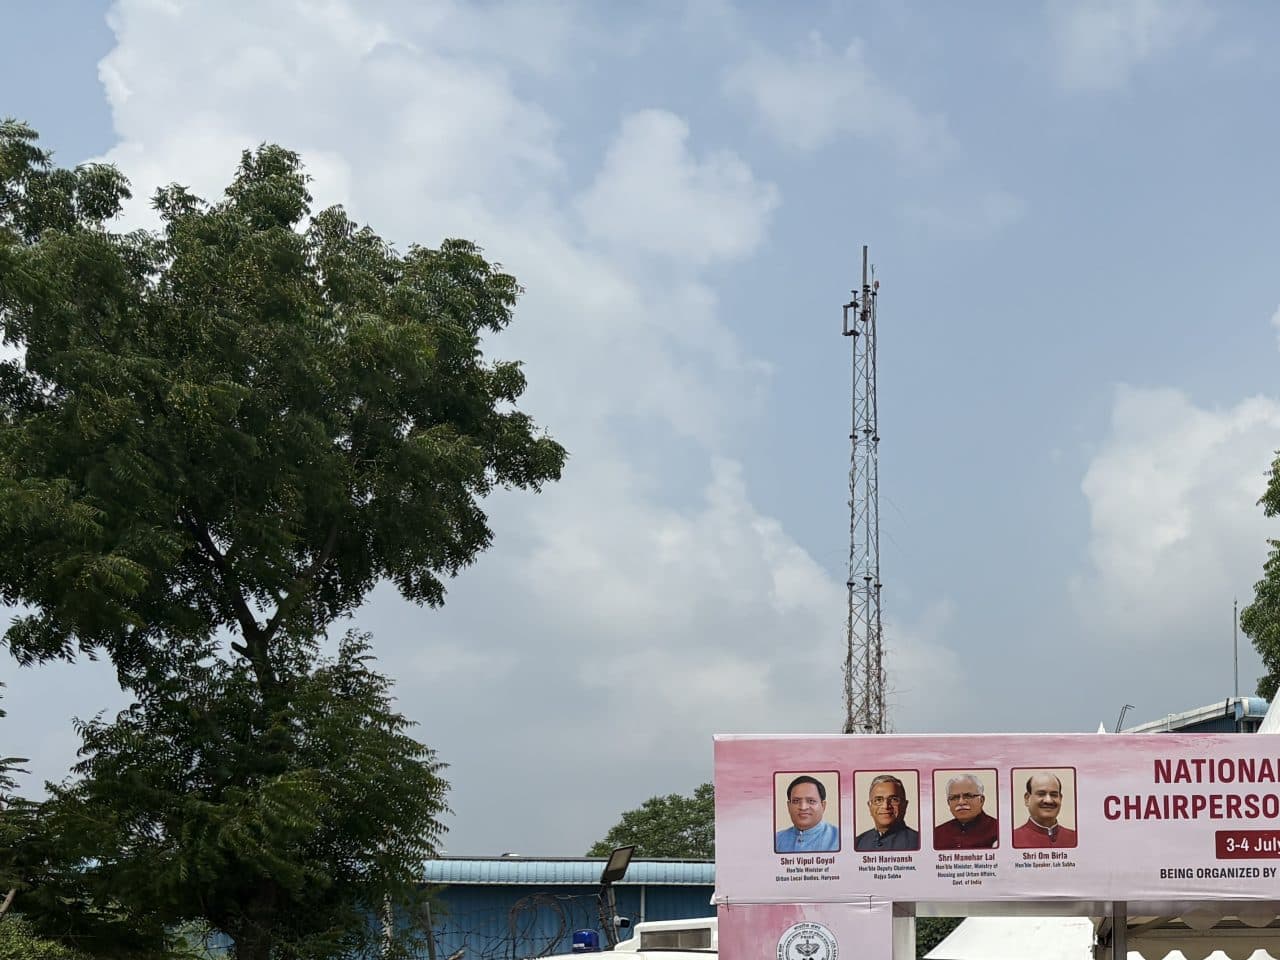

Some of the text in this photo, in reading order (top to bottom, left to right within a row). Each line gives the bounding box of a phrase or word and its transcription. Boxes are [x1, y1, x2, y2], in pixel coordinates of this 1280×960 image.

[1226, 837, 1250, 852] 3-4
[862, 855, 913, 864] Shri Harivansh
[938, 853, 996, 862] Shri Manohar Lal
[1022, 852, 1068, 860] Shri Om Birla
[780, 856, 835, 866] Shri Vipul Goyal
[1160, 868, 1194, 879] BEING
[1196, 867, 1260, 879] ORGANIZED
[1263, 867, 1277, 878] BY
